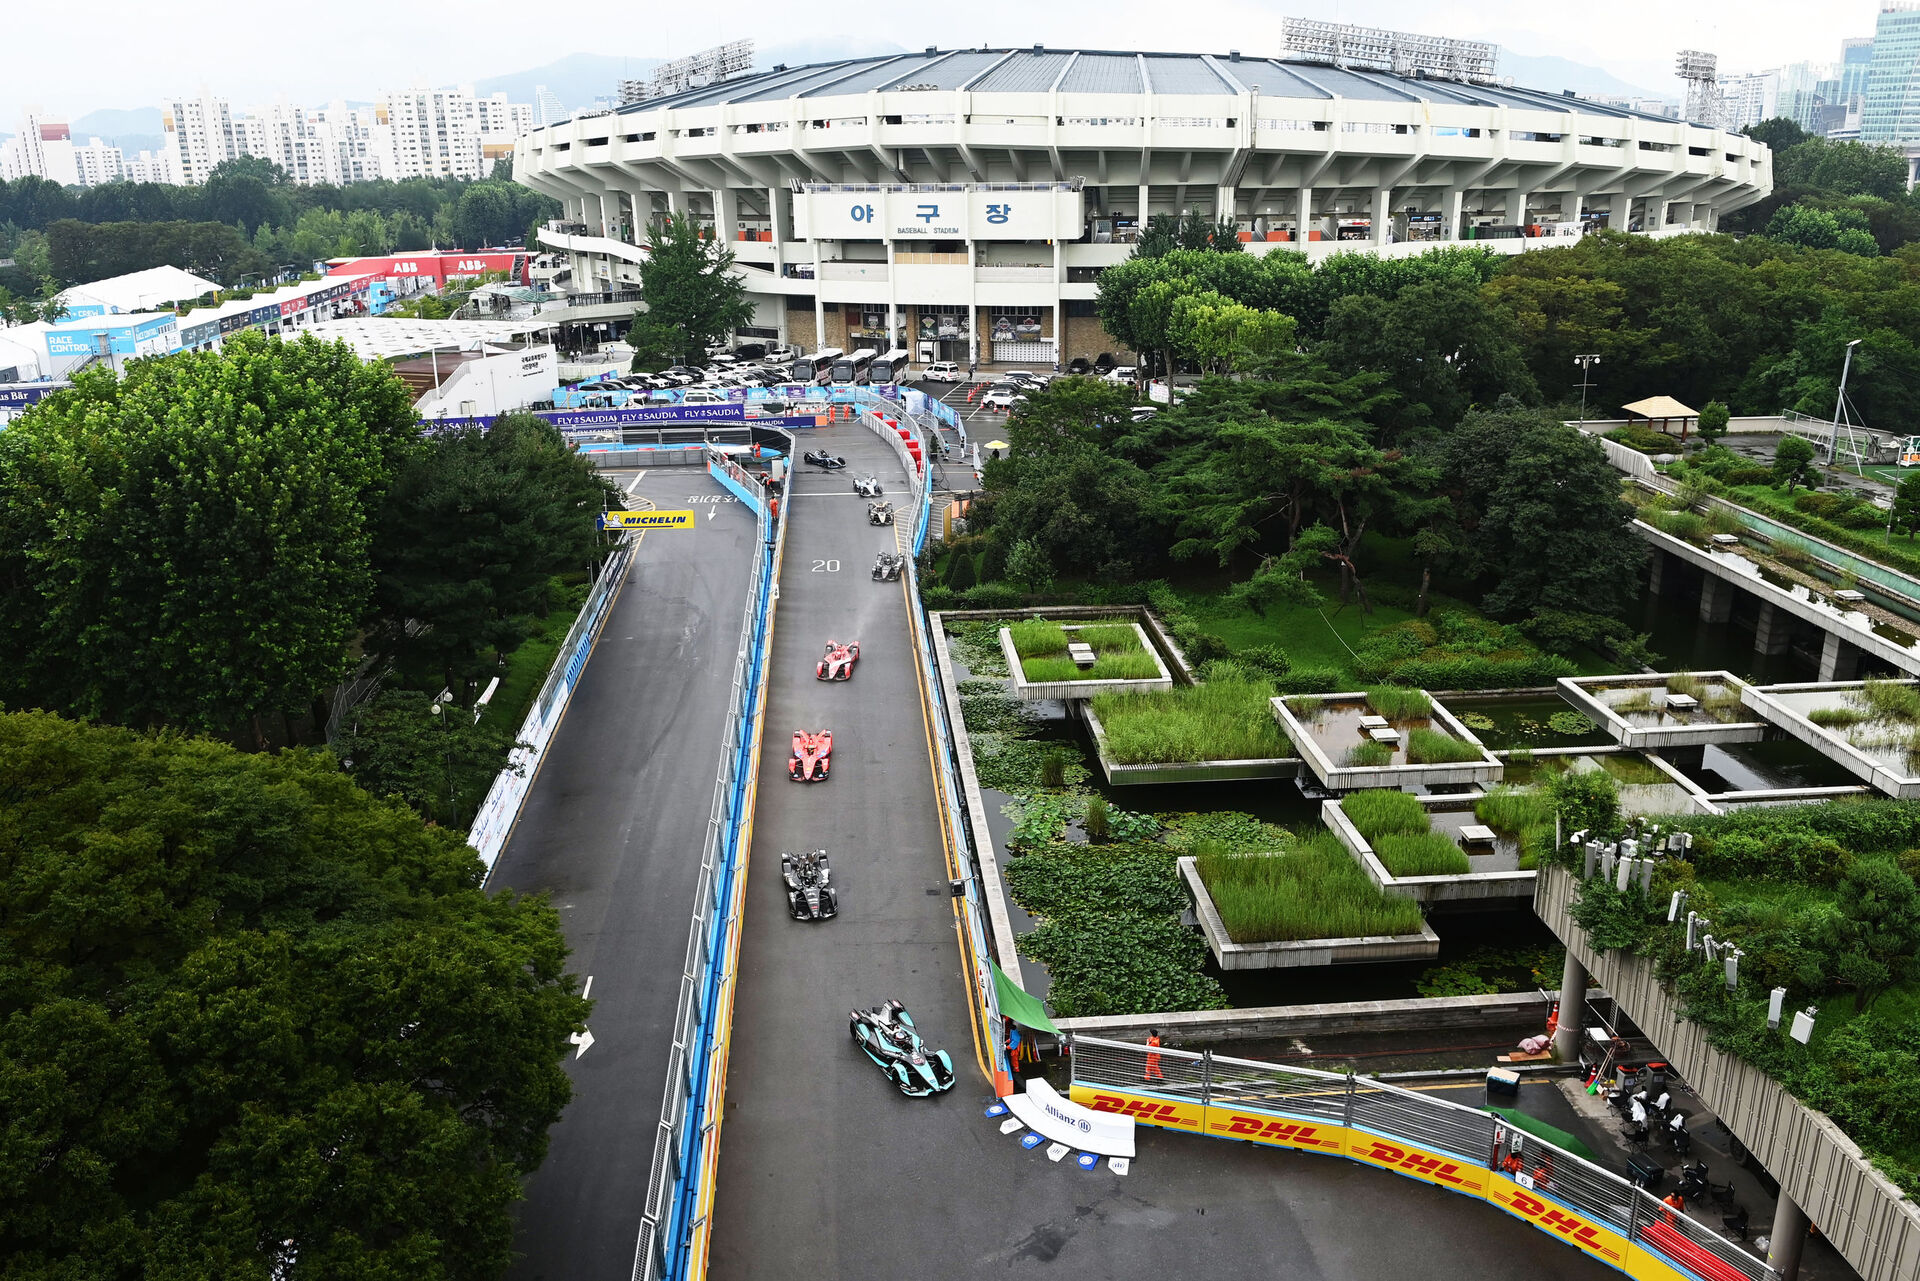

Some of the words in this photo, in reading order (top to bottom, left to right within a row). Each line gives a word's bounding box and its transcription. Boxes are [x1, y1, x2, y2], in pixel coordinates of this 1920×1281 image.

[393, 262, 418, 273] ABB
[458, 260, 482, 271] ABB
[49, 336, 73, 345] RACE
[51, 343, 92, 352] CONTROL
[10, 391, 28, 401] Bär
[621, 413, 637, 421] FLY
[644, 411, 678, 420] SAUDIA
[685, 410, 698, 418] FLY
[706, 408, 741, 417] SAUDIA
[557, 416, 573, 424] FLY
[580, 415, 616, 423] SAUDIA
[624, 516, 687, 524] MICHELIN
[811, 559, 841, 573] 20
[1091, 1094, 1181, 1123] DHL
[1045, 1103, 1076, 1127] Allianz
[1227, 1116, 1322, 1146] DHL
[1368, 1141, 1465, 1185] DHL
[1521, 1176, 1528, 1185] 6
[1510, 1191, 1603, 1250] DHL
